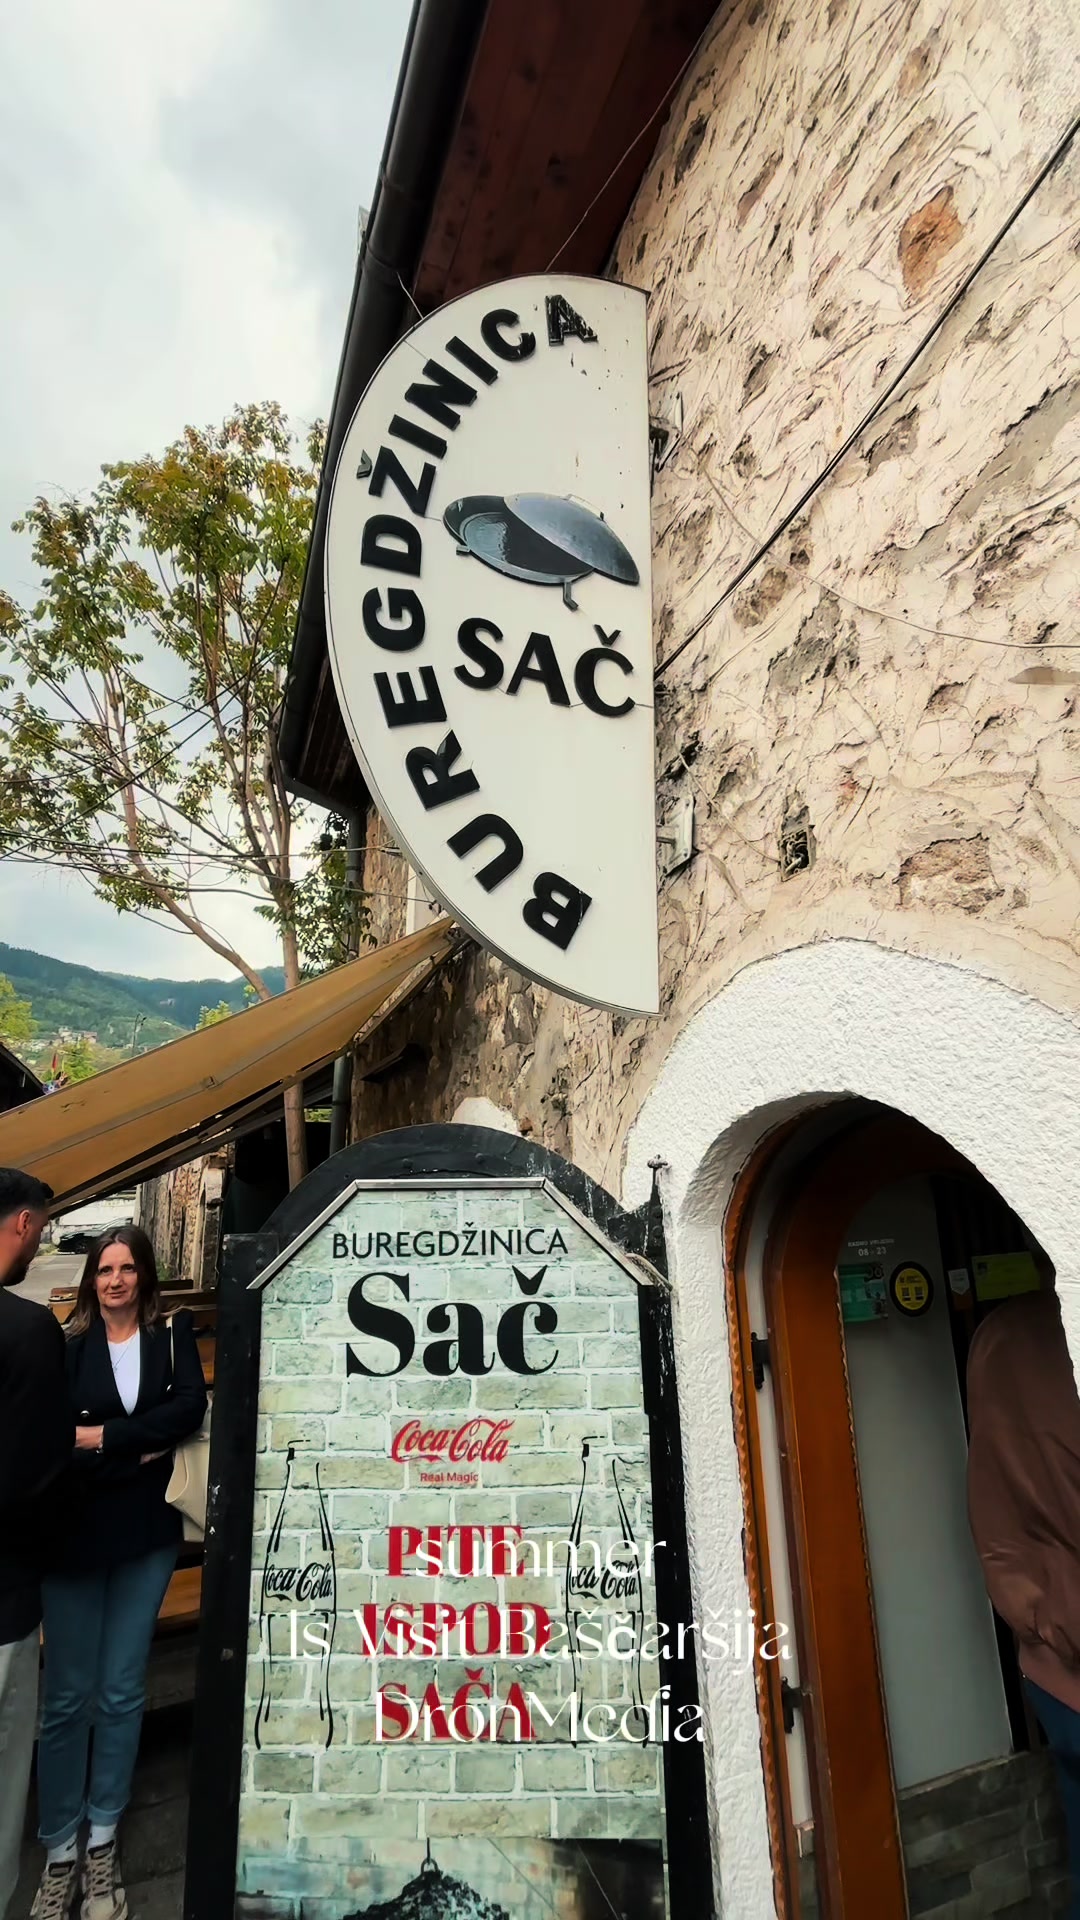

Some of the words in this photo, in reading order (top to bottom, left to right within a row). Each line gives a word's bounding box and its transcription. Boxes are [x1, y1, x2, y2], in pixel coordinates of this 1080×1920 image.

[355, 294, 598, 951] BUREGDŽINICA
[453, 616, 636, 719] SAČ
[332, 1222, 569, 1260] BUREGDŽINICA
[345, 1264, 559, 1378] Sač
[391, 1418, 516, 1464] Coca-Cola
[420, 1472, 444, 1483] Real
[446, 1471, 479, 1484] Magic
[386, 1525, 526, 1578] PITE
[264, 1562, 333, 1602] Coca-Cola
[360, 1601, 552, 1656] ISPOD
[374, 1667, 538, 1740] SAČA
